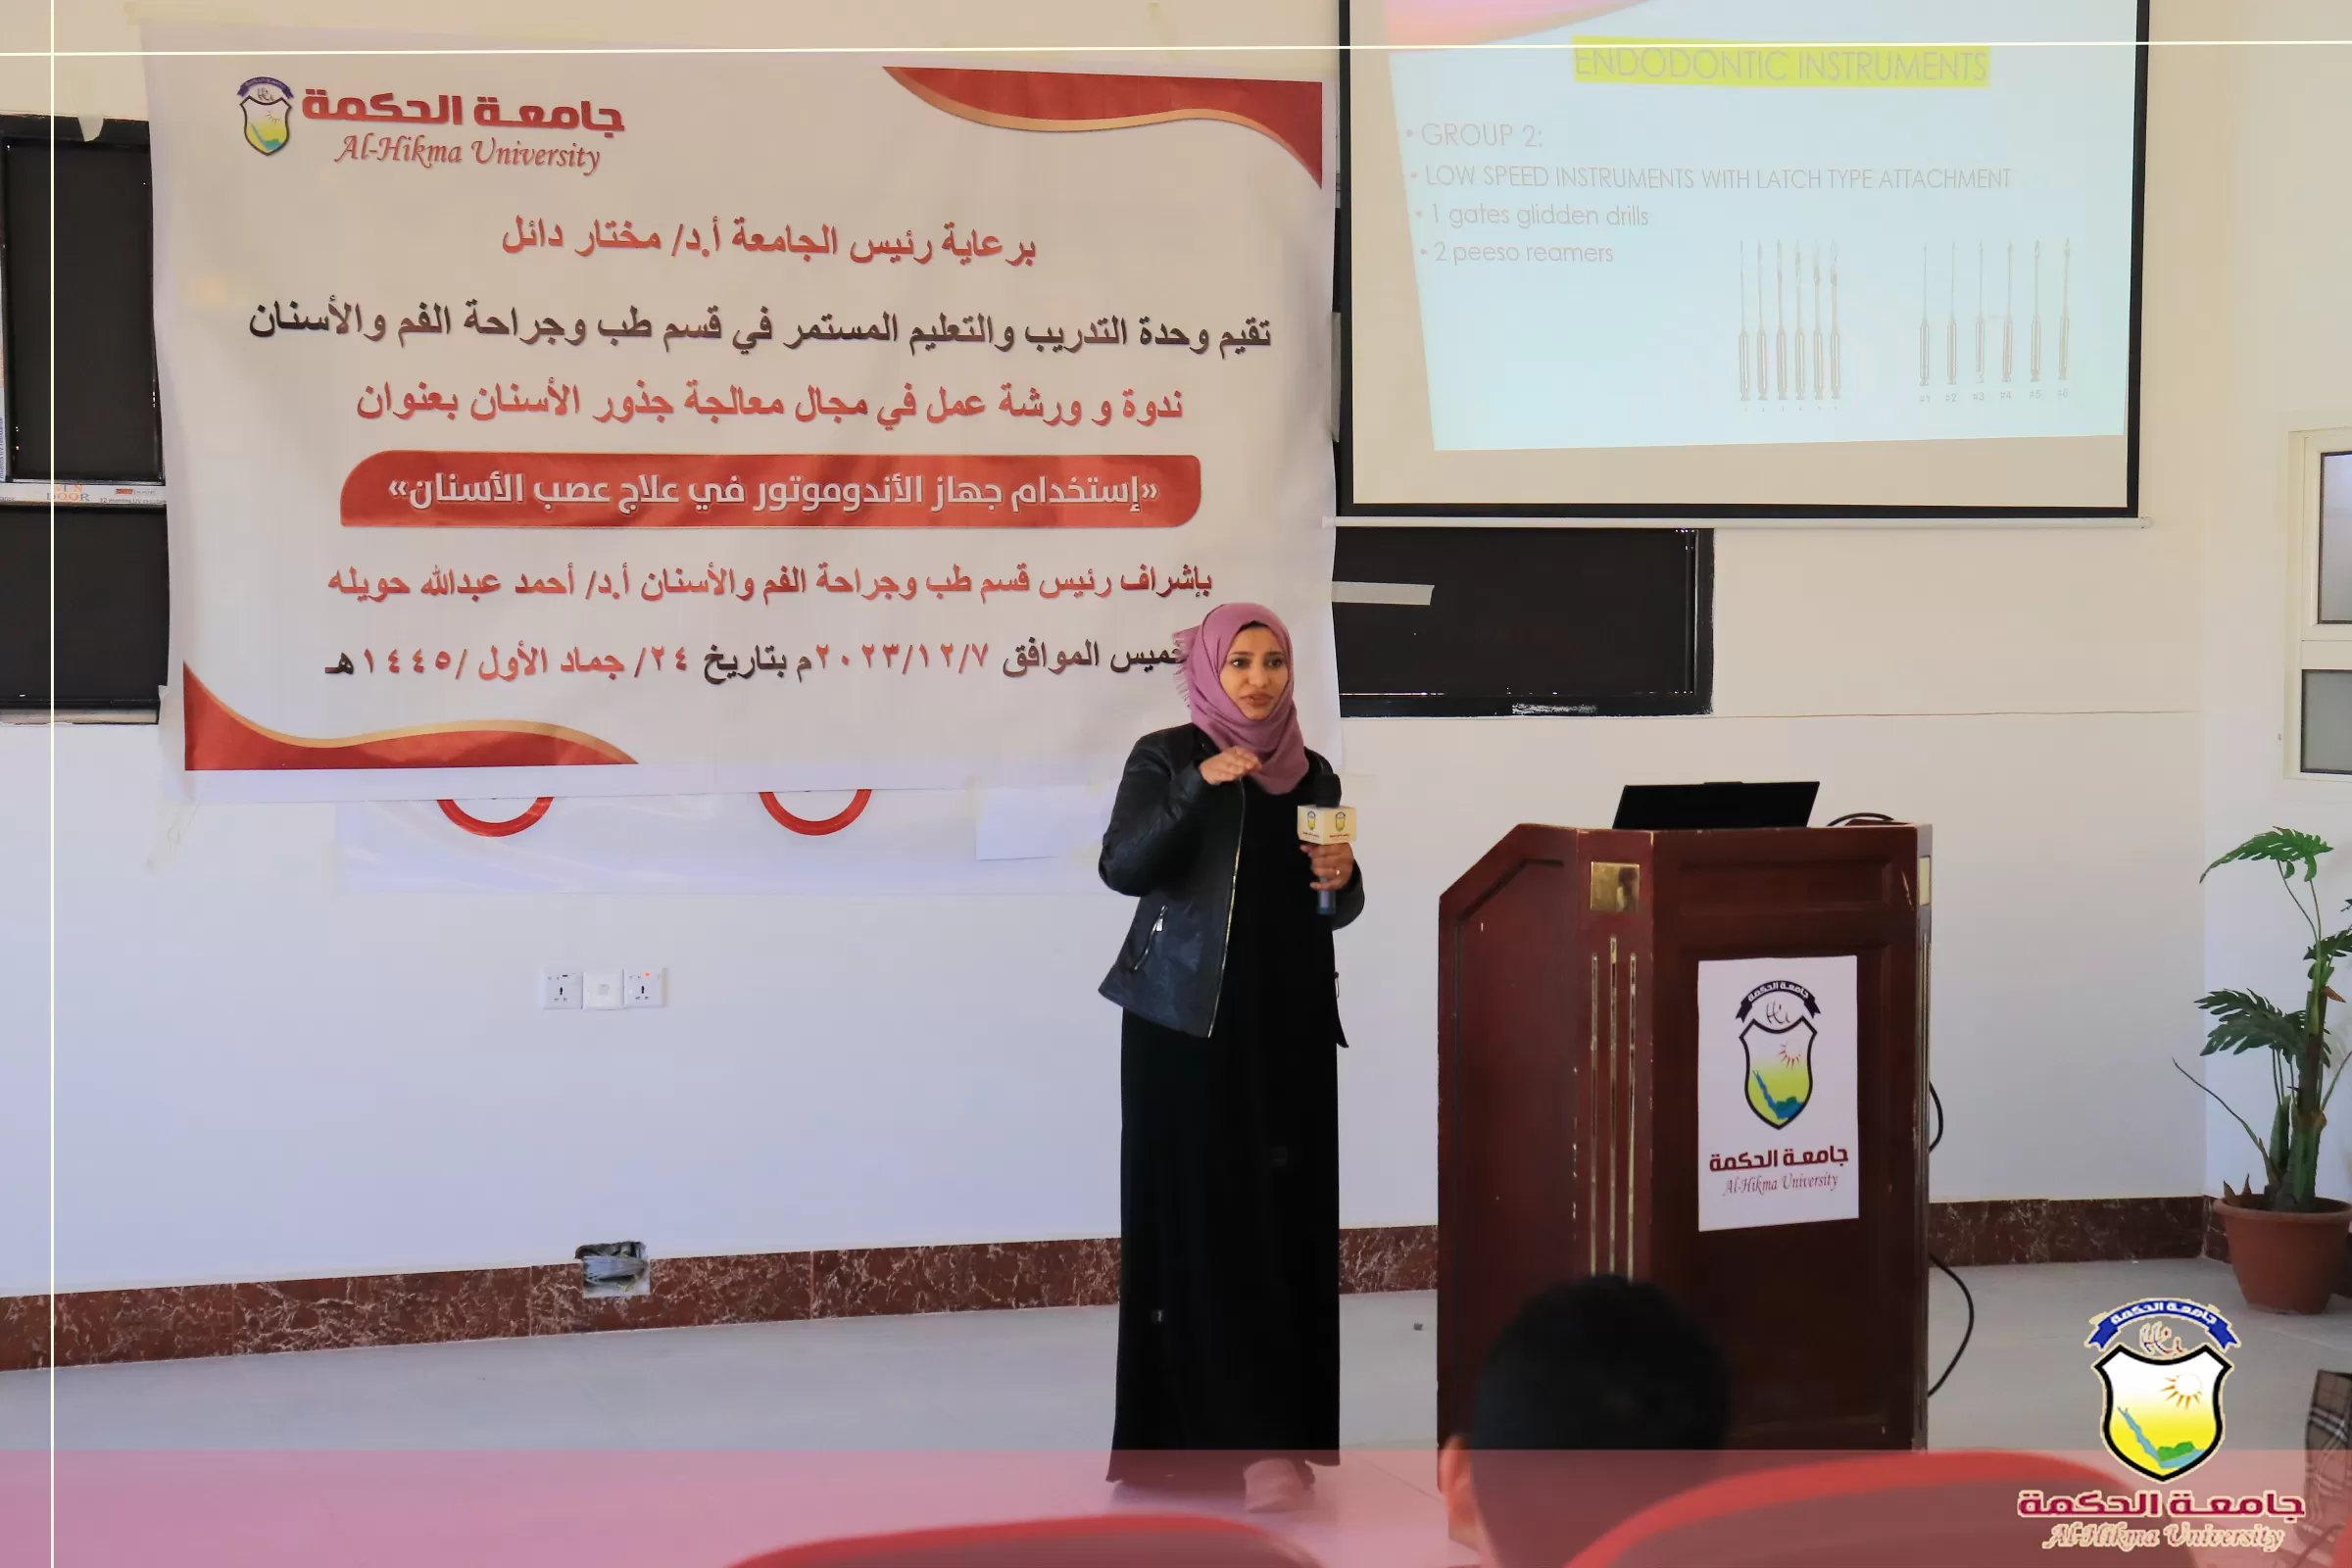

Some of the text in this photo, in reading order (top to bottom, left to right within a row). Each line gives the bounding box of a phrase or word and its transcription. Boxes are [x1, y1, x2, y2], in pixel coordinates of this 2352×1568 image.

[1574, 46, 1987, 82] ENDODONTIC INSTRUMENTS
[303, 88, 625, 137] جامعة الحكمة
[1421, 122, 1543, 148] GROUP 2:
[334, 134, 600, 175] Al-Hikma University
[1426, 165, 2011, 189] LOW SPEED INSTRUMENTS WITH LATCH TYPE ATTACHMENT
[502, 216, 563, 254] دائل
[1432, 204, 1649, 229] 1 gates glidden drills
[576, 220, 661, 257] مختار
[732, 217, 836, 262] الجامعة
[851, 227, 932, 264] رئيس
[942, 222, 1036, 266] برعاية
[1435, 241, 1614, 267] 2 peeso reamers
[249, 295, 1271, 360] تقيم وحدة التدريب والتعليم المستمر في قسم طب وجراحة الفم والأسنان
[357, 382, 459, 419] بعنوان
[470, 376, 580, 421] الأسنان
[593, 380, 673, 422] جذور
[684, 380, 783, 423] معالجة
[795, 384, 868, 424] مجال
[877, 382, 916, 429] في
[927, 385, 985, 424] عمل
[1000, 382, 1081, 425] ورشة
[1123, 387, 1183, 425] ندوة
[533, 482, 611, 511] عصب
[618, 474, 680, 514] علاج
[689, 475, 745, 512] في
[754, 472, 922, 513] الأندوموتور
[932, 476, 1003, 513] جهاز
[421, 564, 501, 603] عبدالله
[514, 563, 574, 594] أحمد
[641, 563, 755, 602] والأسنان
[763, 564, 806, 605] الفم
[815, 562, 916, 599] وجراحة
[925, 564, 971, 599] طب
[980, 564, 1029, 603] قسم
[1039, 569, 1111, 599] رئيس
[1121, 564, 1212, 598] بإشراف
[478, 640, 547, 681] الأول
[561, 646, 624, 680] جماد
[705, 646, 787, 685] بتاريخ
[1004, 637, 1099, 678] الموافق
[1747, 982, 1810, 1002] جامعة الحكمة
[1710, 1146, 1848, 1172] جامعة الحكمة
[1723, 1173, 1838, 1197] Al-Hikma University
